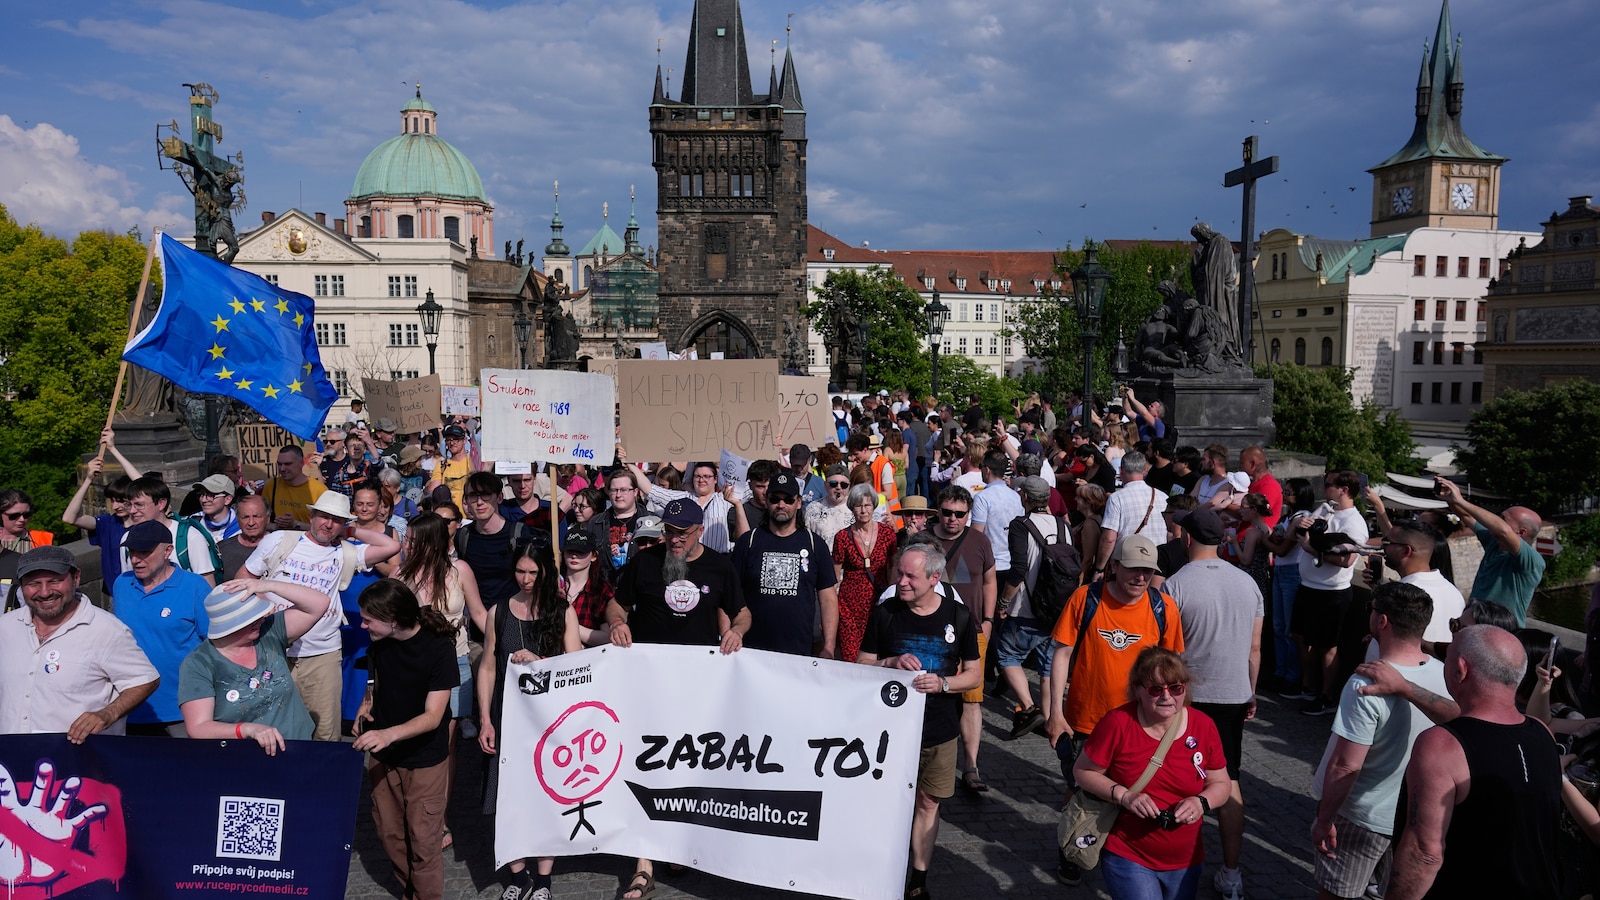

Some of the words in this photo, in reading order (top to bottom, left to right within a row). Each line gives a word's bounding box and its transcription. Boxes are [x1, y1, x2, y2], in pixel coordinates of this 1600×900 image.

[488, 374, 536, 396] Studenti
[730, 381, 743, 404] JE
[748, 371, 776, 404] TO
[386, 402, 395, 412] to
[400, 400, 424, 412] radši
[795, 388, 818, 406] to
[522, 403, 541, 412] roce
[549, 402, 569, 415] 1989
[778, 410, 815, 441] TA
[238, 426, 295, 448] KULTURA
[241, 448, 271, 465] KULT
[549, 445, 565, 455] ani
[572, 442, 594, 460] dnes
[760, 588, 797, 596] 1918-1938
[555, 669, 574, 678] RUCE
[575, 664, 592, 674] PRYČ
[554, 680, 566, 689] OD
[552, 728, 607, 768] OTO
[635, 731, 784, 774] ZABAL
[807, 730, 890, 780] TO!
[653, 796, 808, 827] www.otozabalto.cz
[192, 864, 234, 877] Připojte
[235, 865, 256, 879] svůj
[257, 870, 295, 880] podpis!
[175, 881, 309, 895] www.ruceprycodmedii.cz
